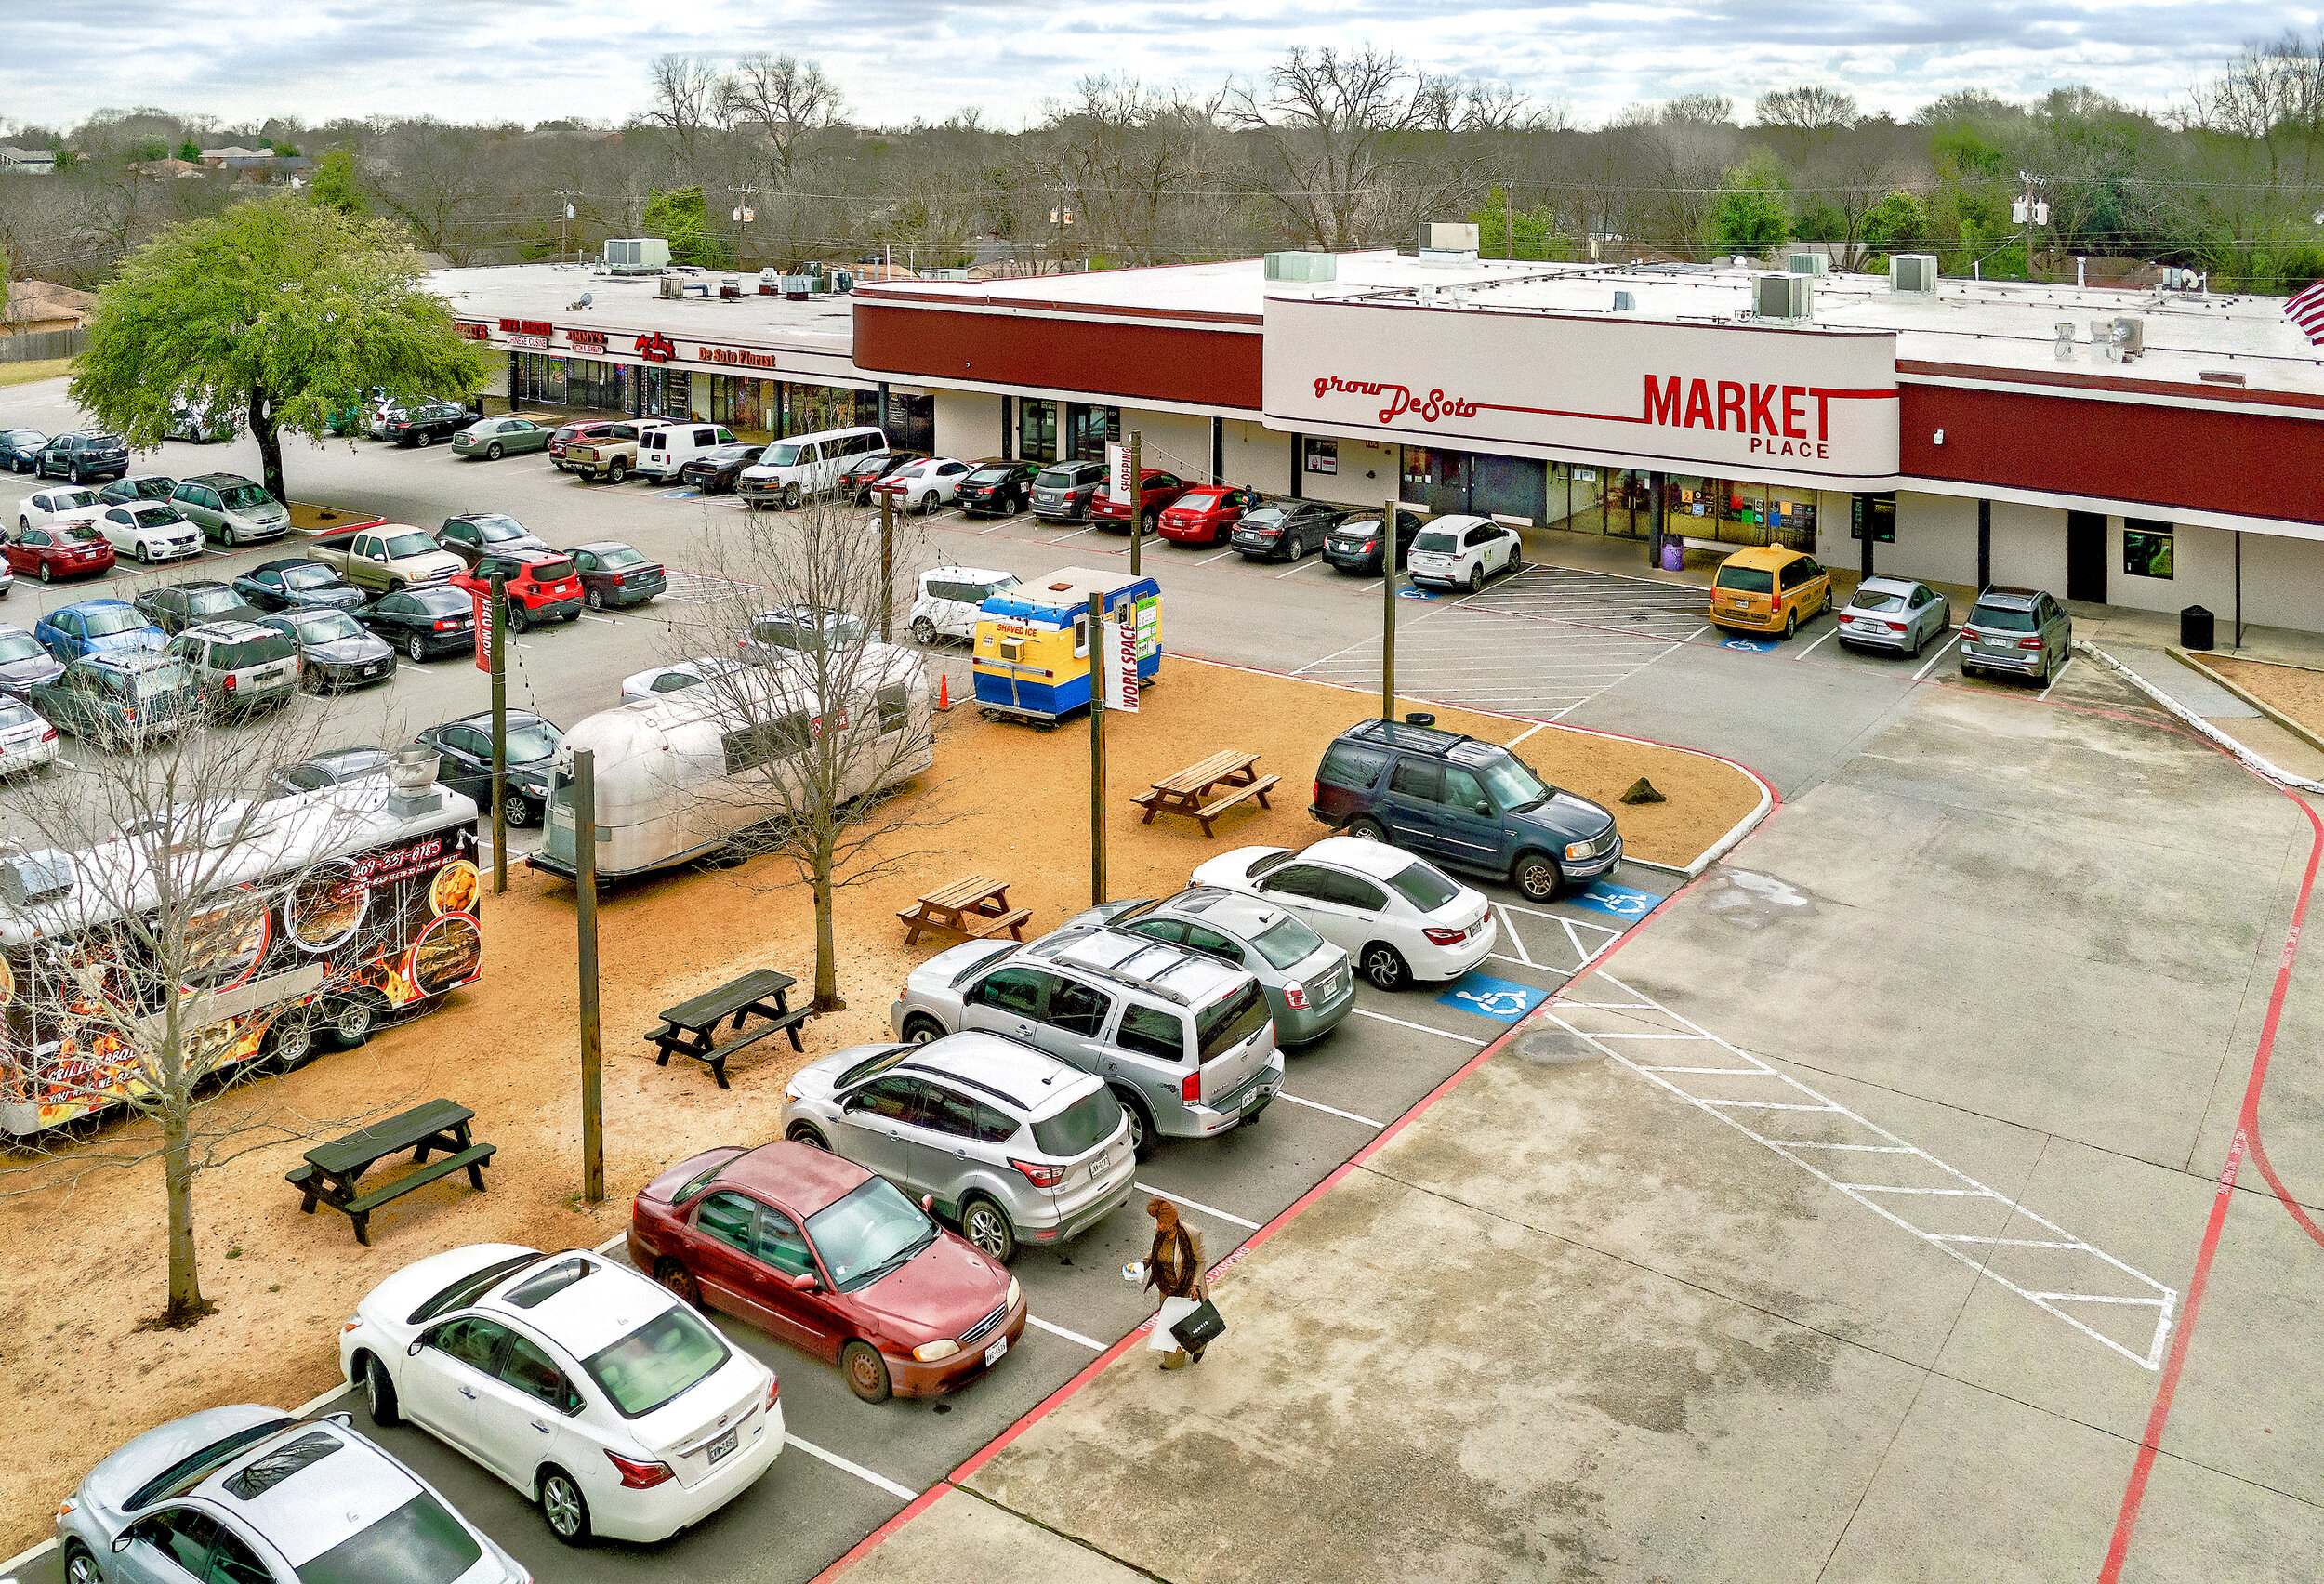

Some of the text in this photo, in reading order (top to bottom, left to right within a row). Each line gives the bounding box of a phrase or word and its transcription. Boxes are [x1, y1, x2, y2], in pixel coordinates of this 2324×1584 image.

[508, 335, 527, 346] CHINESE
[521, 320, 552, 336] GARDEN
[565, 330, 604, 344] JIMMY'S
[699, 347, 775, 367] De Soto Florist
[1314, 376, 1477, 424] grow DeSoto
[1644, 374, 1829, 441] MARKET
[1750, 437, 1829, 459] PLACE
[1121, 447, 1132, 492] SHOPPING
[482, 598, 493, 627] OPEN
[997, 624, 1037, 638] SHAVED ICE
[1120, 624, 1139, 708] WORK SPACE
[1211, 1246, 1251, 1278] PARKING
